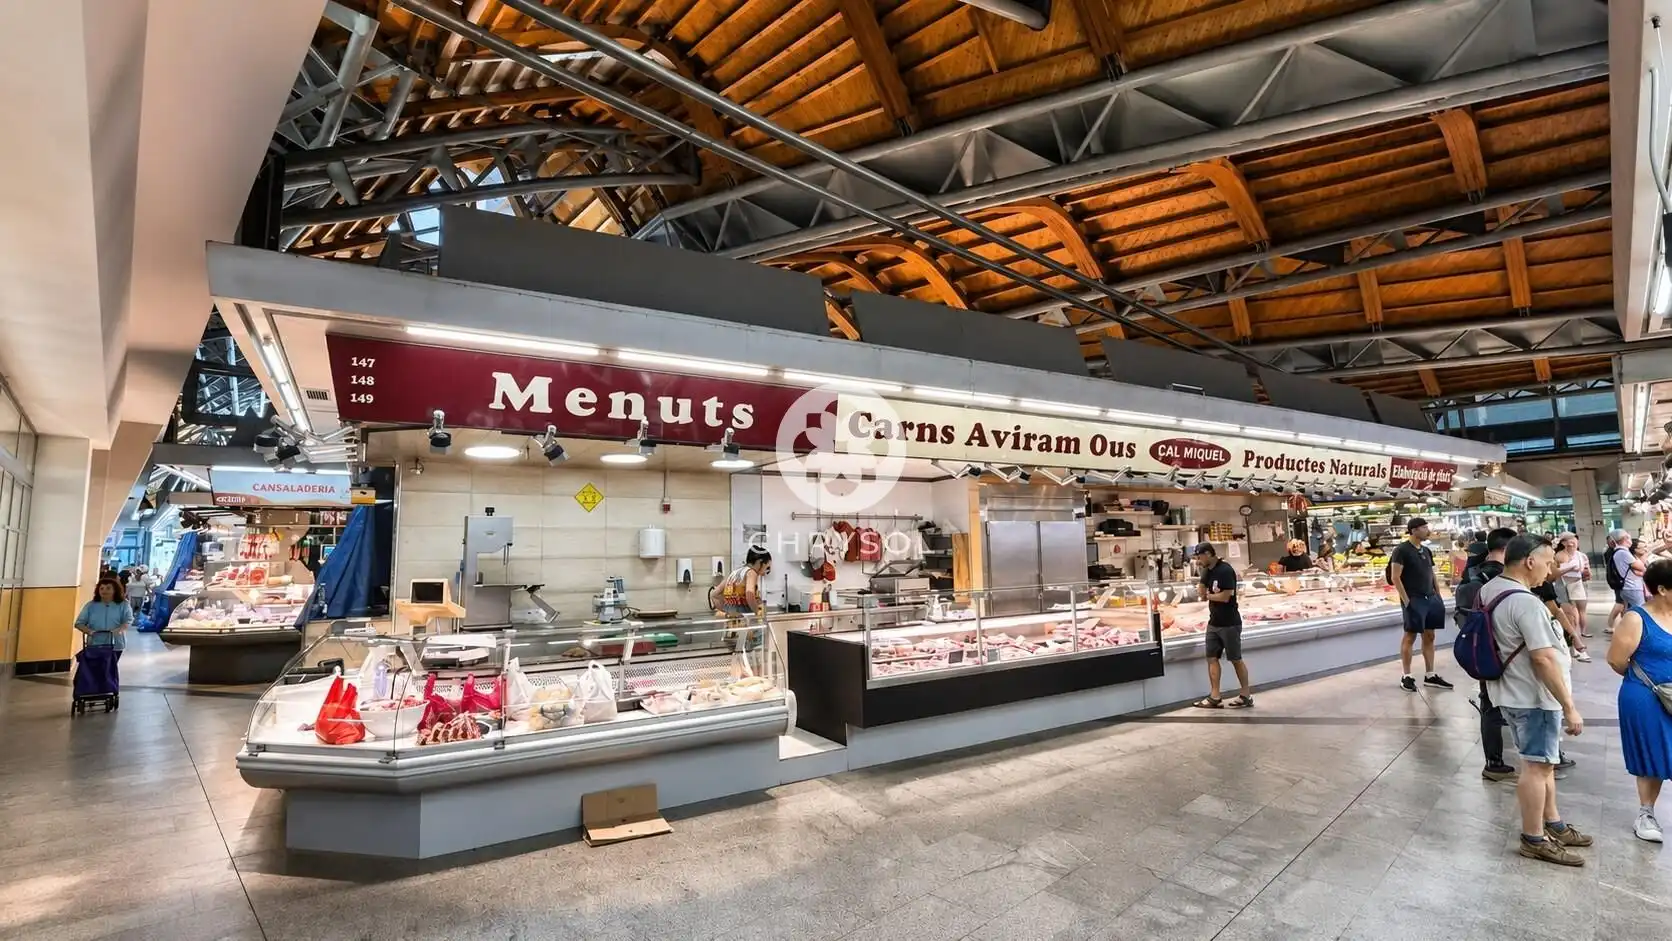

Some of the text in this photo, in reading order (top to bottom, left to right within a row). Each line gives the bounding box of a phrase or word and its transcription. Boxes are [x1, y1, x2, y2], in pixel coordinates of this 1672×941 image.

[351, 356, 376, 368] 147
[350, 375, 375, 386] 148
[349, 393, 374, 404] 149
[488, 371, 755, 430] Menuts
[848, 410, 1137, 459] Carns Aviram Ous
[1158, 444, 1226, 462] CAL MIQUEL
[1242, 449, 1388, 479] Productes Naturals
[1392, 464, 1428, 481] Elaboració
[1428, 468, 1436, 482] de
[252, 482, 336, 494] CANSALADERIA
